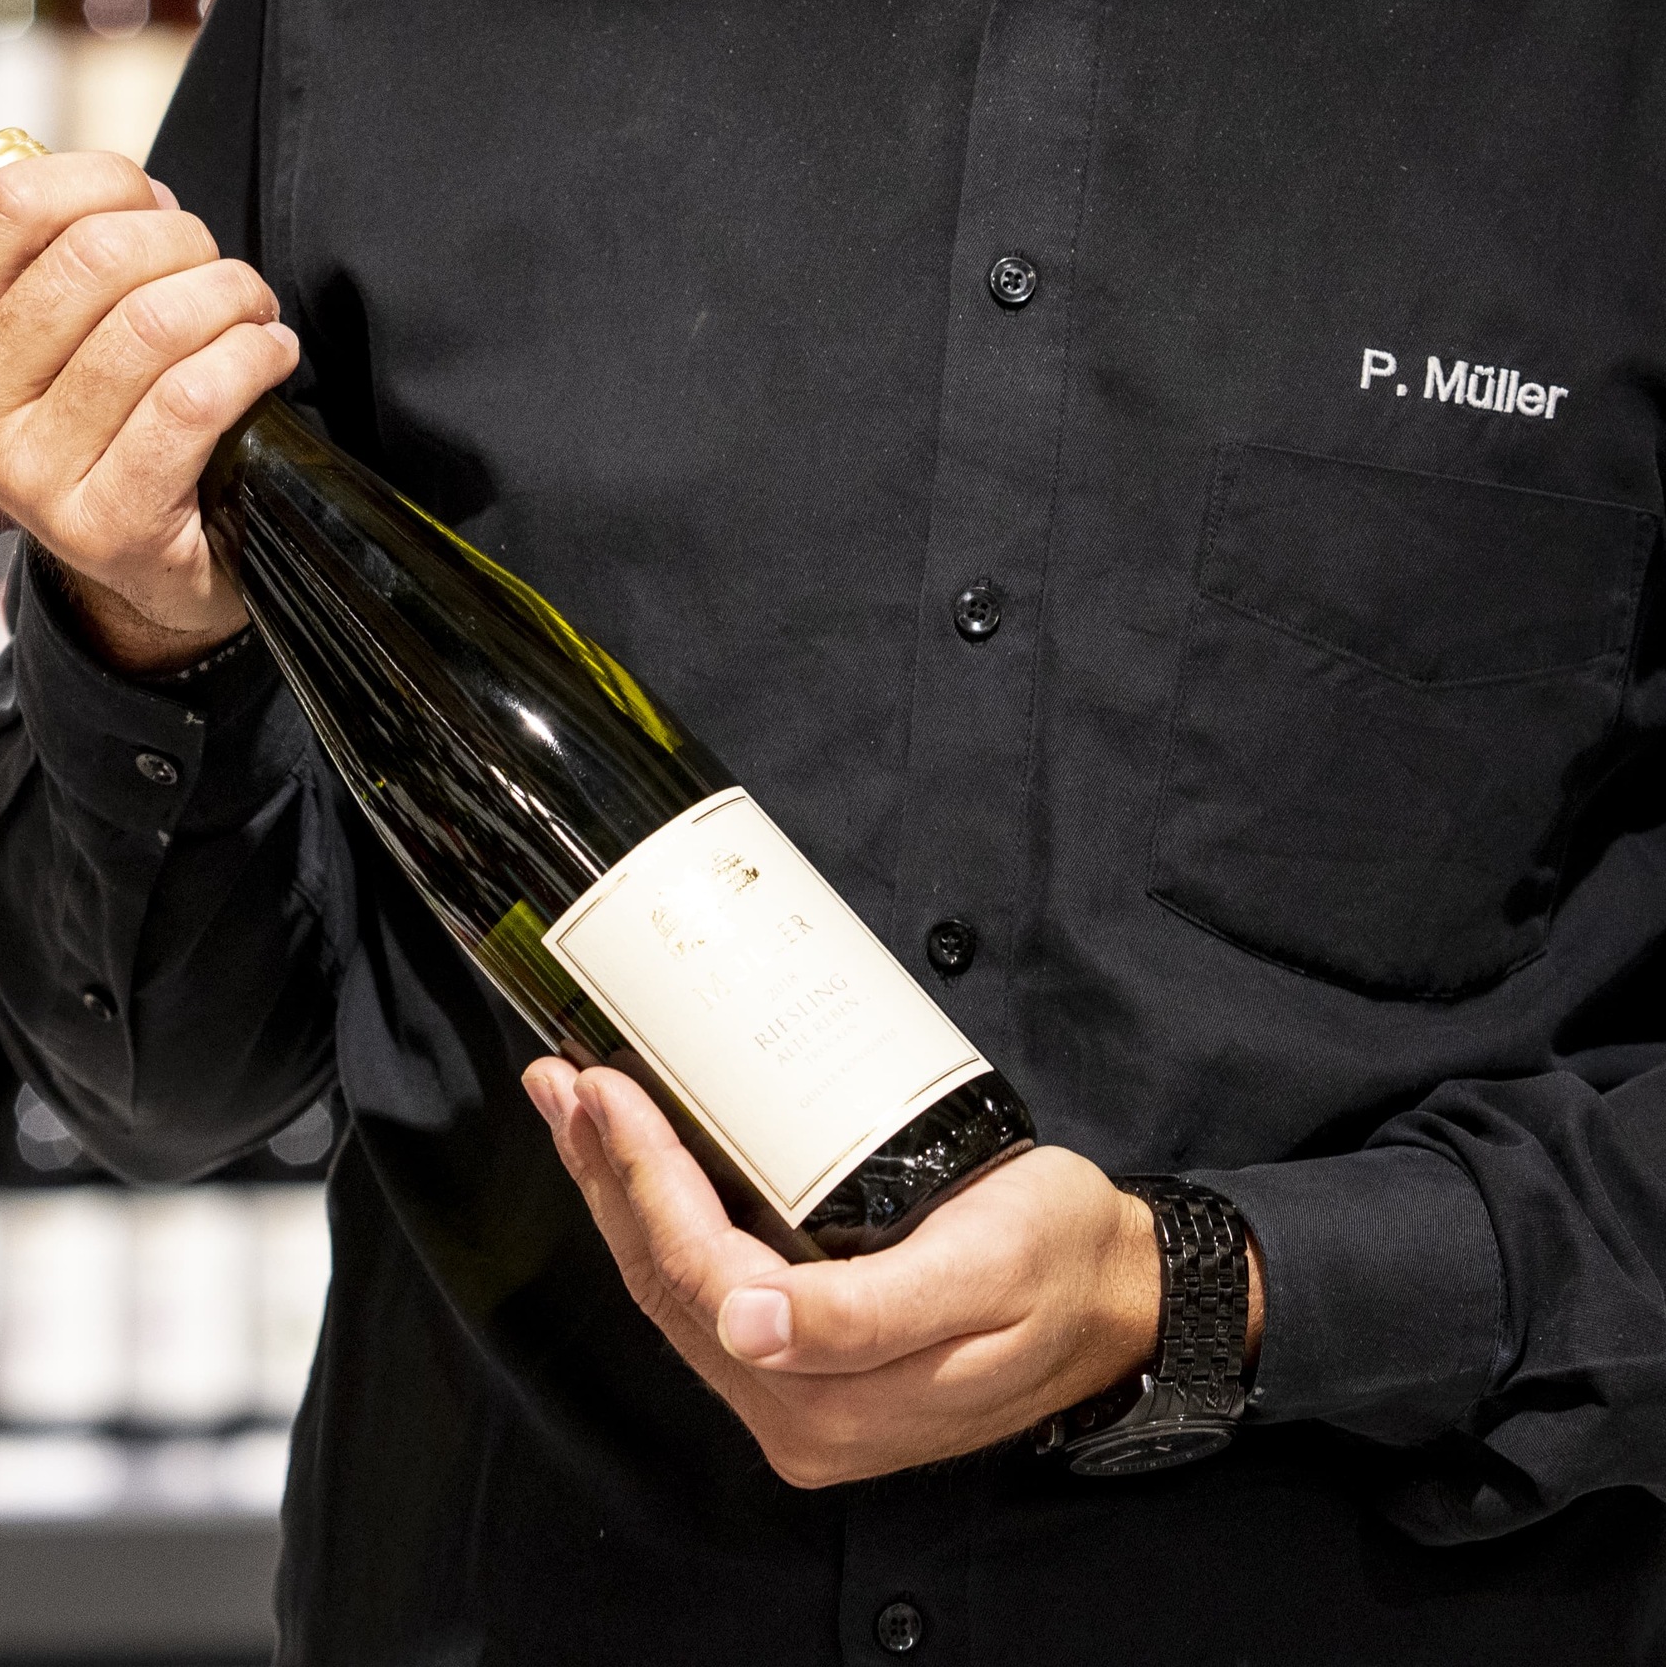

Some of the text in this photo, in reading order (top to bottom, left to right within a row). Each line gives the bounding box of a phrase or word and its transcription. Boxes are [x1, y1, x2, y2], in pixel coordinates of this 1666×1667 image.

[1360, 347, 1569, 420] P. Müller
[753, 972, 848, 1051] RIESLING
[765, 971, 802, 1003] 2018
[812, 995, 860, 1035] REBEN
